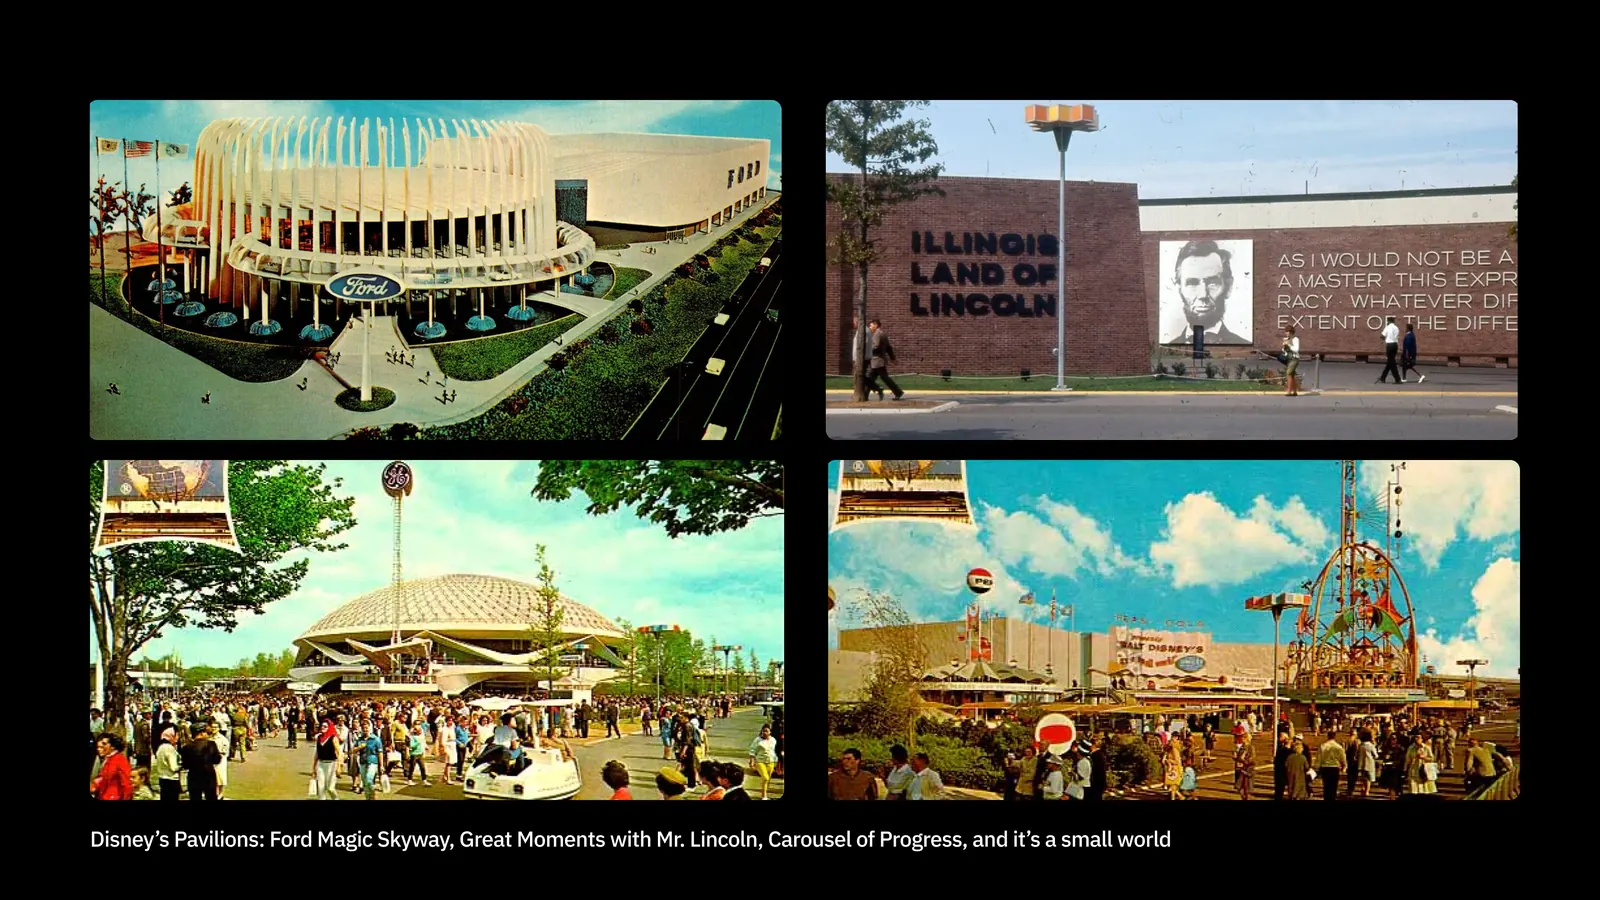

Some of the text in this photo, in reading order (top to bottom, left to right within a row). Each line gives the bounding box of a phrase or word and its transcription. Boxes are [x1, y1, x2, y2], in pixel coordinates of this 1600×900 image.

[727, 160, 760, 189] FORD
[911, 230, 1059, 257] ILLINOIS
[1278, 250, 1514, 268] AS I WOULD NOT BE A
[911, 262, 1058, 286] LAND OF
[1278, 271, 1518, 288] A MASTER THIS EXPR
[342, 276, 389, 296] Ford
[910, 292, 1057, 317] LINCOLN
[1278, 293, 1518, 309] RACY WHATEVER DIF
[1277, 315, 1518, 331] EXTENT OF THE DIFFE
[1148, 644, 1204, 654] DISNEY'S
